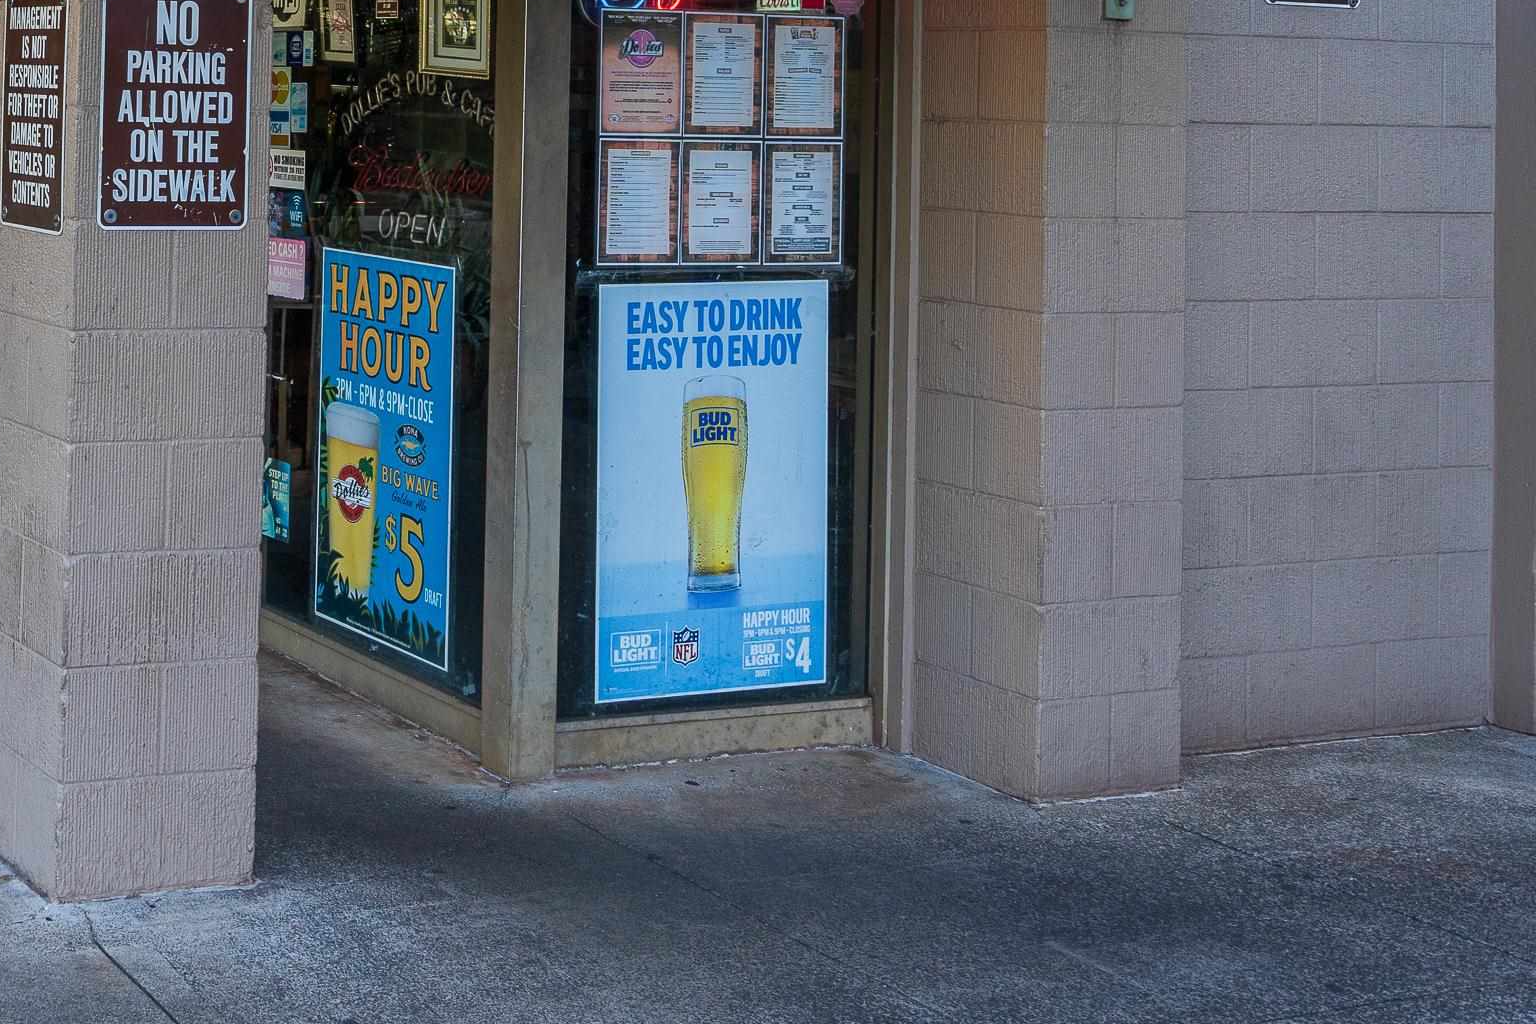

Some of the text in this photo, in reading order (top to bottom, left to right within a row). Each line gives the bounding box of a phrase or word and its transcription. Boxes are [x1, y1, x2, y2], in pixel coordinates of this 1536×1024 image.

[9, 5, 62, 30] MANAGEMENT
[156, 0, 199, 46] NO
[21, 35, 47, 60] IS NOT
[9, 64, 58, 89] RESPONSIBLE
[127, 50, 225, 85] PARKING
[8, 93, 58, 120] FOR THEFT OR
[117, 90, 233, 126] ALLOWED
[341, 71, 400, 136] DOLLIE'S
[406, 70, 437, 96] PUB
[441, 80, 456, 107] &
[11, 122, 53, 149] DAMAGE TO
[130, 129, 219, 163] ON THE
[8, 150, 55, 179] VEHICLES OR
[11, 179, 50, 208] CONTENTS
[112, 169, 236, 203] SIDEWALK
[378, 209, 448, 247] OPEN
[278, 241, 297, 258] CASH
[330, 263, 448, 334] HAPPY
[627, 297, 802, 335] EASY TO DRINK
[339, 319, 432, 392] HOUR
[626, 333, 802, 371] EASY TO ENJOY
[335, 378, 352, 402] 3PM
[359, 383, 376, 409] 6PM
[378, 390, 385, 411] &
[403, 426, 418, 438] KONA
[699, 412, 731, 426] BUD
[693, 426, 736, 443] LIGHT
[381, 464, 440, 501] BIG WAVE
[424, 587, 442, 609] DRAFT
[744, 607, 810, 628] HAPPY HOUR
[620, 634, 651, 648] BUD
[675, 643, 696, 660] NFL
[751, 643, 775, 655] BUD
[614, 647, 658, 664] LIGHT
[745, 653, 780, 666] LIGHT
